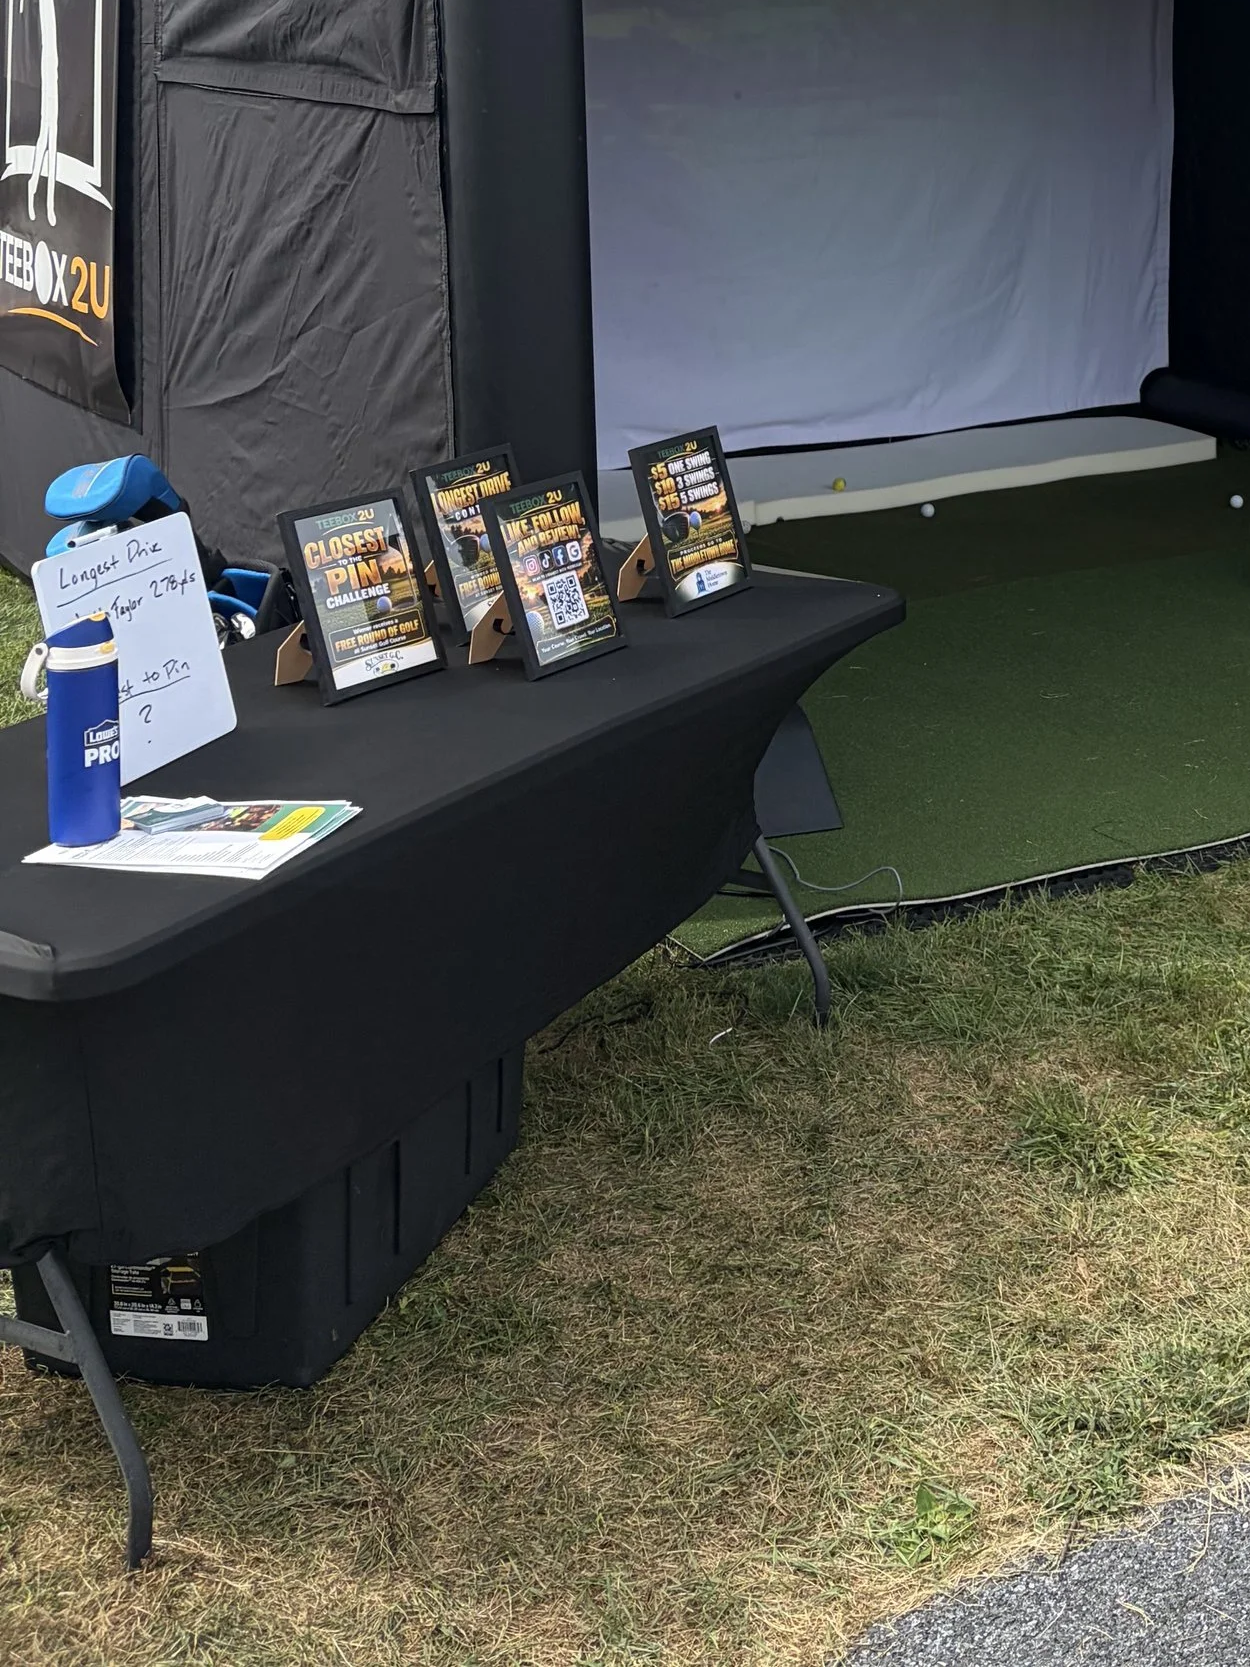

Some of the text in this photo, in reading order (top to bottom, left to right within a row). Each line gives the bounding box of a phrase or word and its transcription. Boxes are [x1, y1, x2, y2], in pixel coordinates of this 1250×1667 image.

[0, 230, 110, 319] TEEBOX 2U
[685, 440, 697, 451] 2U
[476, 461, 491, 474] 2U
[651, 451, 711, 480] $5 ONE SWING
[430, 471, 511, 515] LONGEST DRIVE
[655, 466, 715, 495] $10 3 SWINGS
[509, 490, 562, 514] TEEBOX 2U
[659, 481, 719, 511] $15 5 SWINGS
[316, 508, 375, 530] TEEBOX 2U
[455, 504, 481, 521] CONT
[531, 501, 586, 534] FOLLOW,
[304, 526, 388, 570] CLOSEST
[517, 524, 581, 558] AND REVIEW!
[59, 555, 120, 589] Longest
[337, 555, 362, 567] TO THE
[324, 559, 382, 596] PIN
[110, 595, 144, 622] Taylor
[326, 583, 391, 610] CHALLENGE
[334, 619, 419, 653] FREE ROUND OF GOLF
[352, 626, 372, 634] Winner
[373, 620, 394, 629] receives
[360, 643, 378, 653] Sunset
[379, 639, 389, 647] Golf
[390, 635, 407, 644] Course
[142, 659, 190, 684] to Pin
[138, 704, 152, 744] ?
[84, 740, 119, 768] PRO
